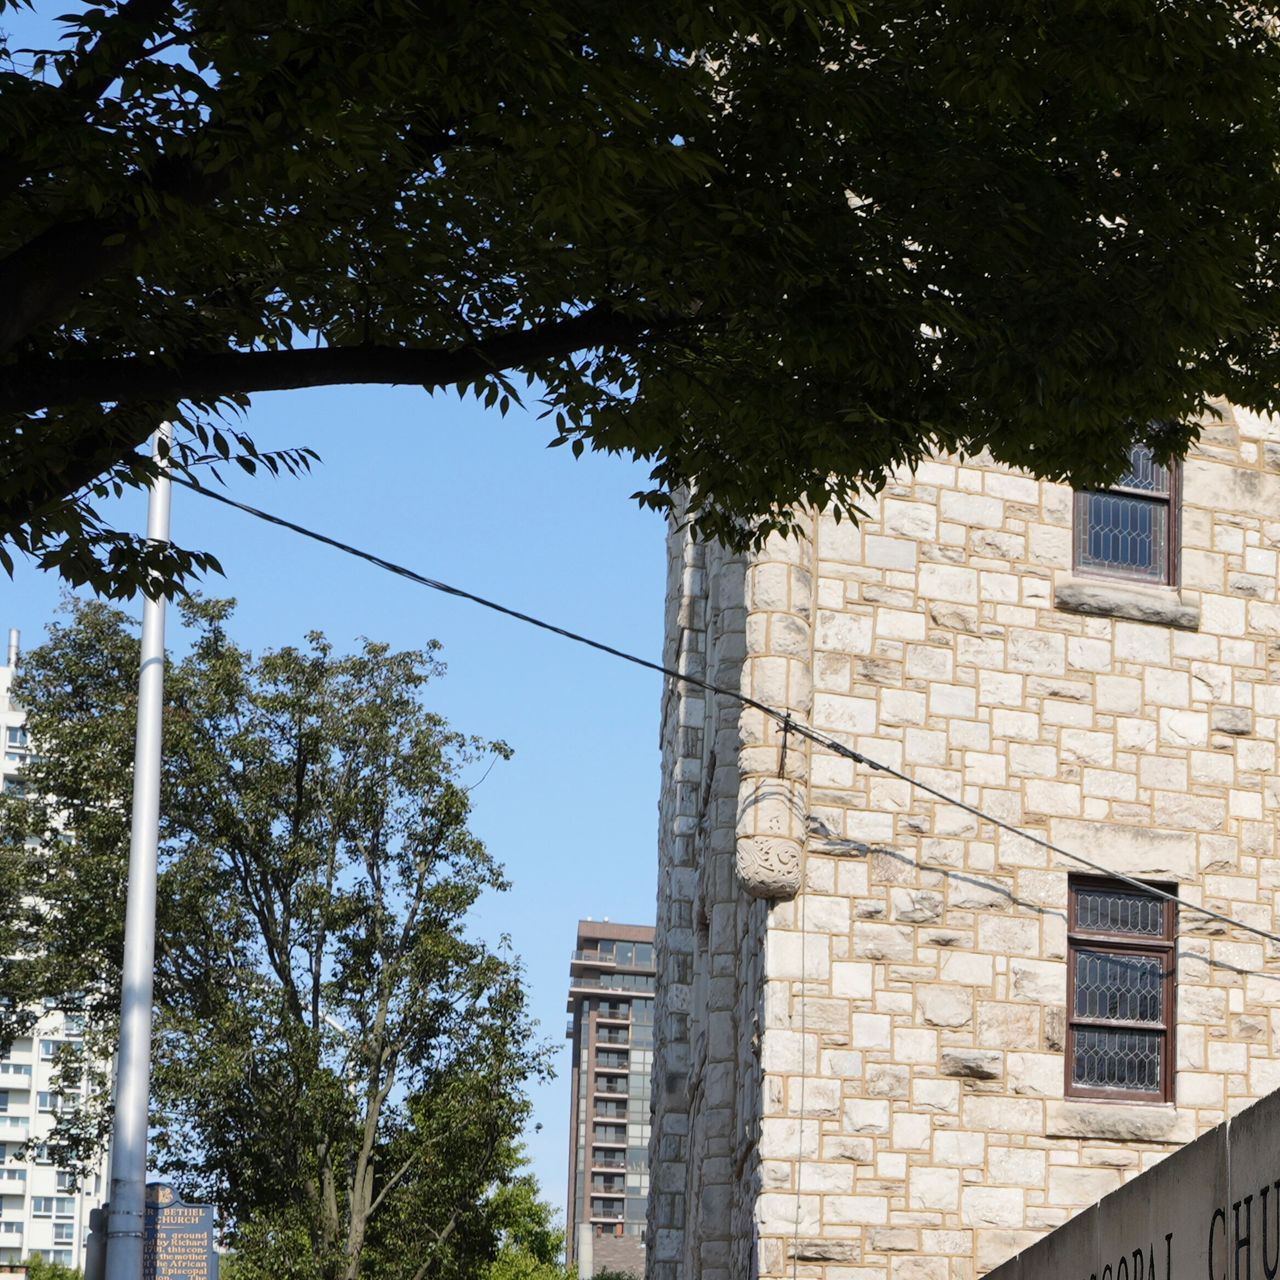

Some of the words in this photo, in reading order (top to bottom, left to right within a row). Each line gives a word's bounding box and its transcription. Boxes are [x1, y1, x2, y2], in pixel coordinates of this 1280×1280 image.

[164, 1208, 205, 1216] BETHEL
[157, 1216, 199, 1224] CHURCH
[157, 1239, 169, 1247] by
[162, 1268, 208, 1276] Episcopal
